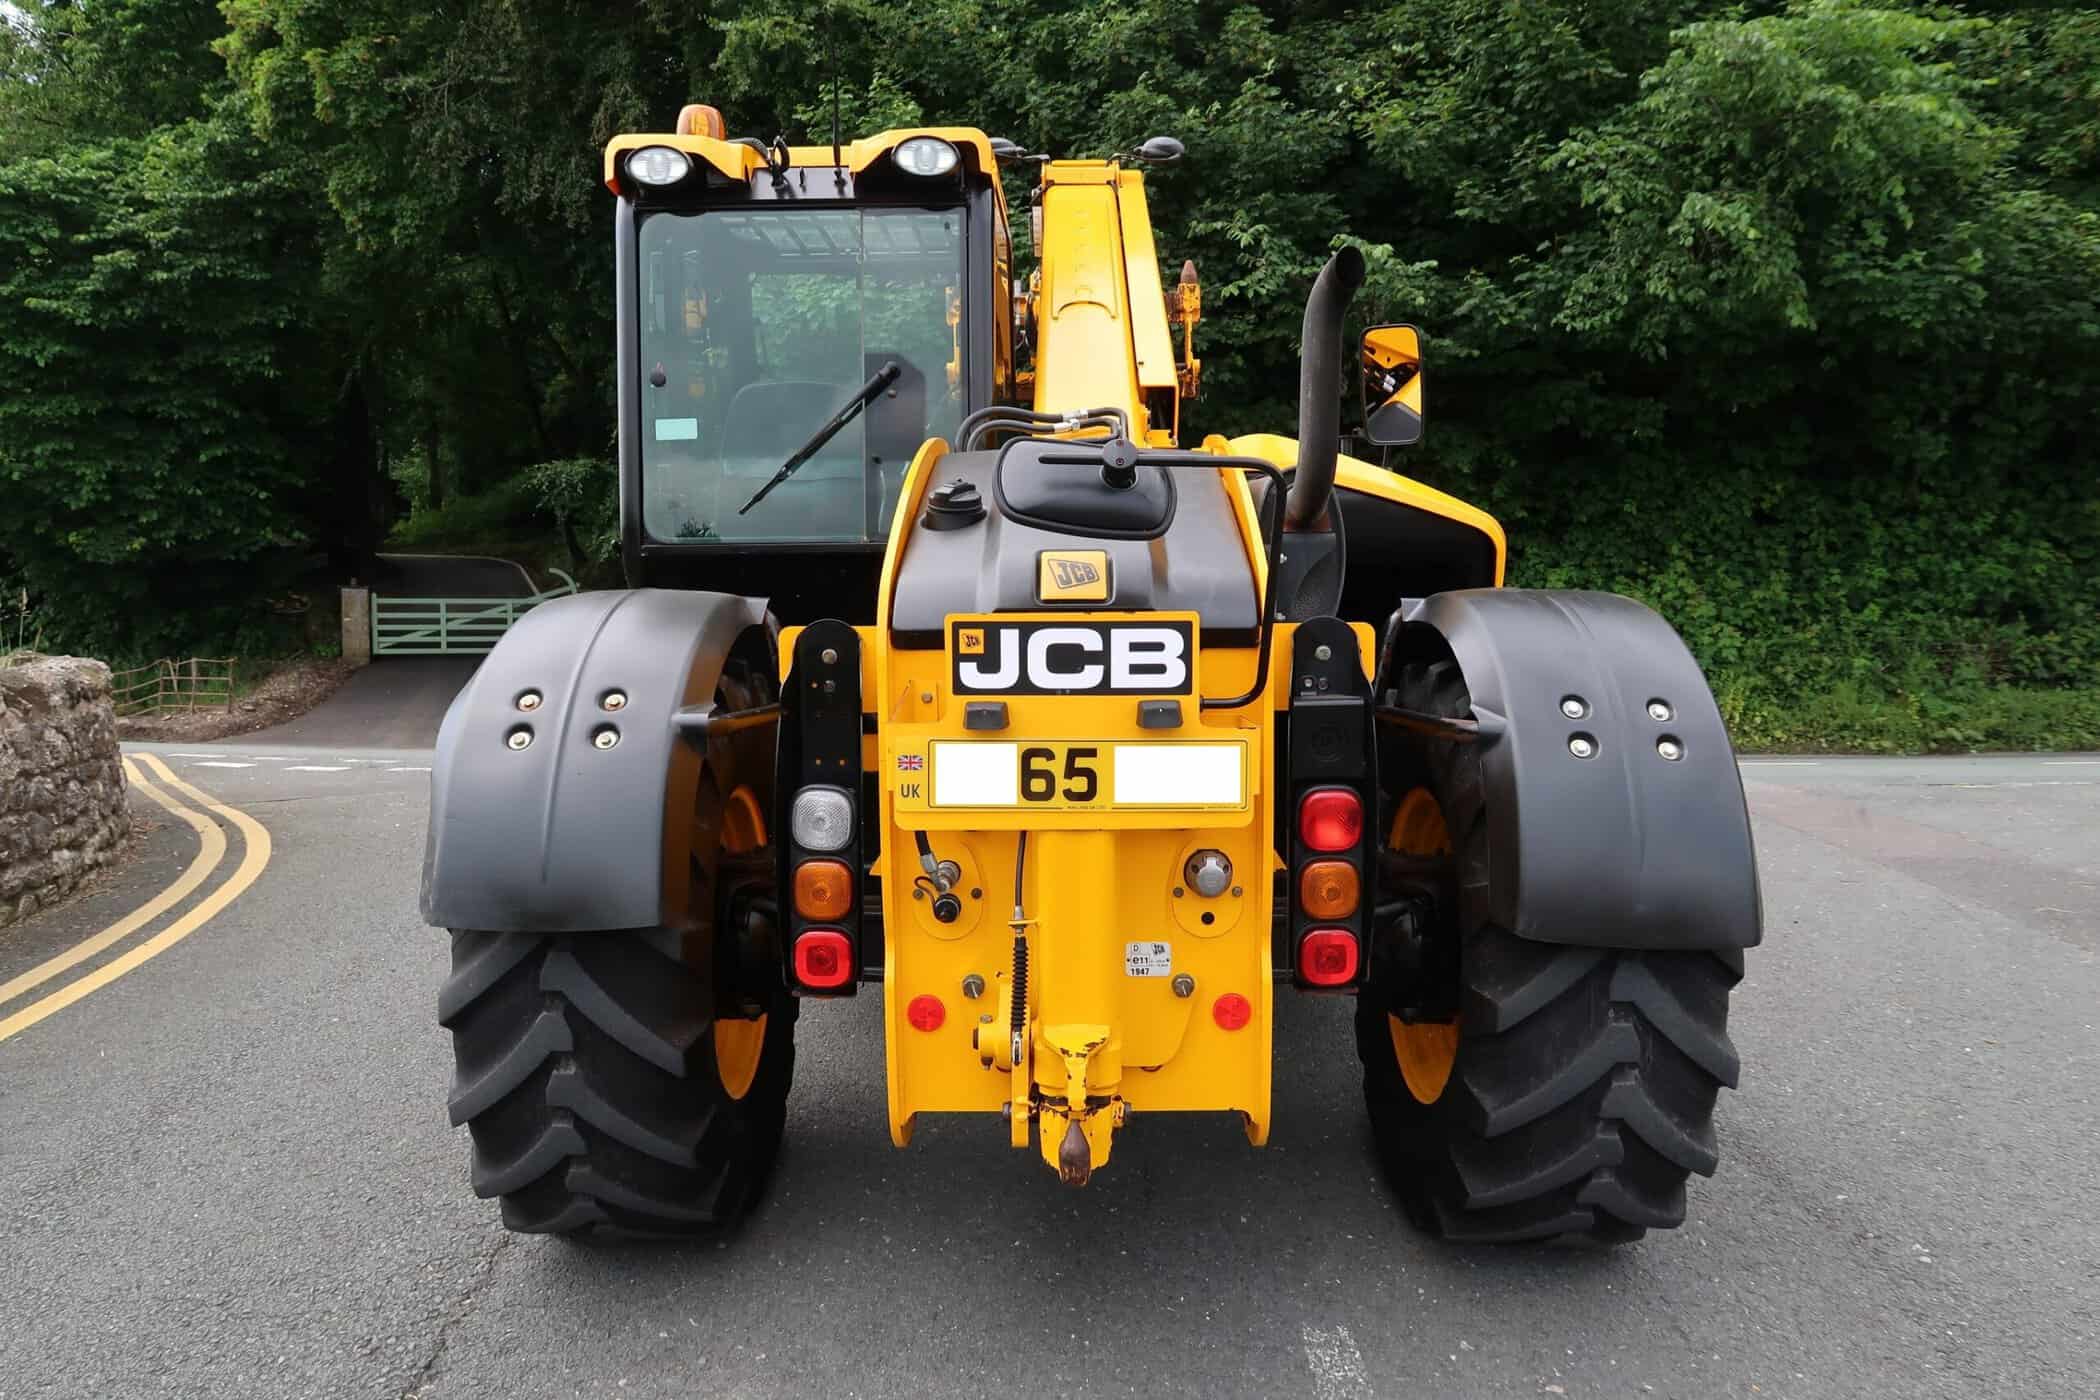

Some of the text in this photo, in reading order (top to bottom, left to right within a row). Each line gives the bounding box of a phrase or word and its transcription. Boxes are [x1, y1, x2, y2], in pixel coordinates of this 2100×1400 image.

[1057, 562, 1095, 585] JCB
[959, 628, 1186, 690] JCB
[900, 783, 921, 799] UK
[1020, 747, 1098, 802] 65
